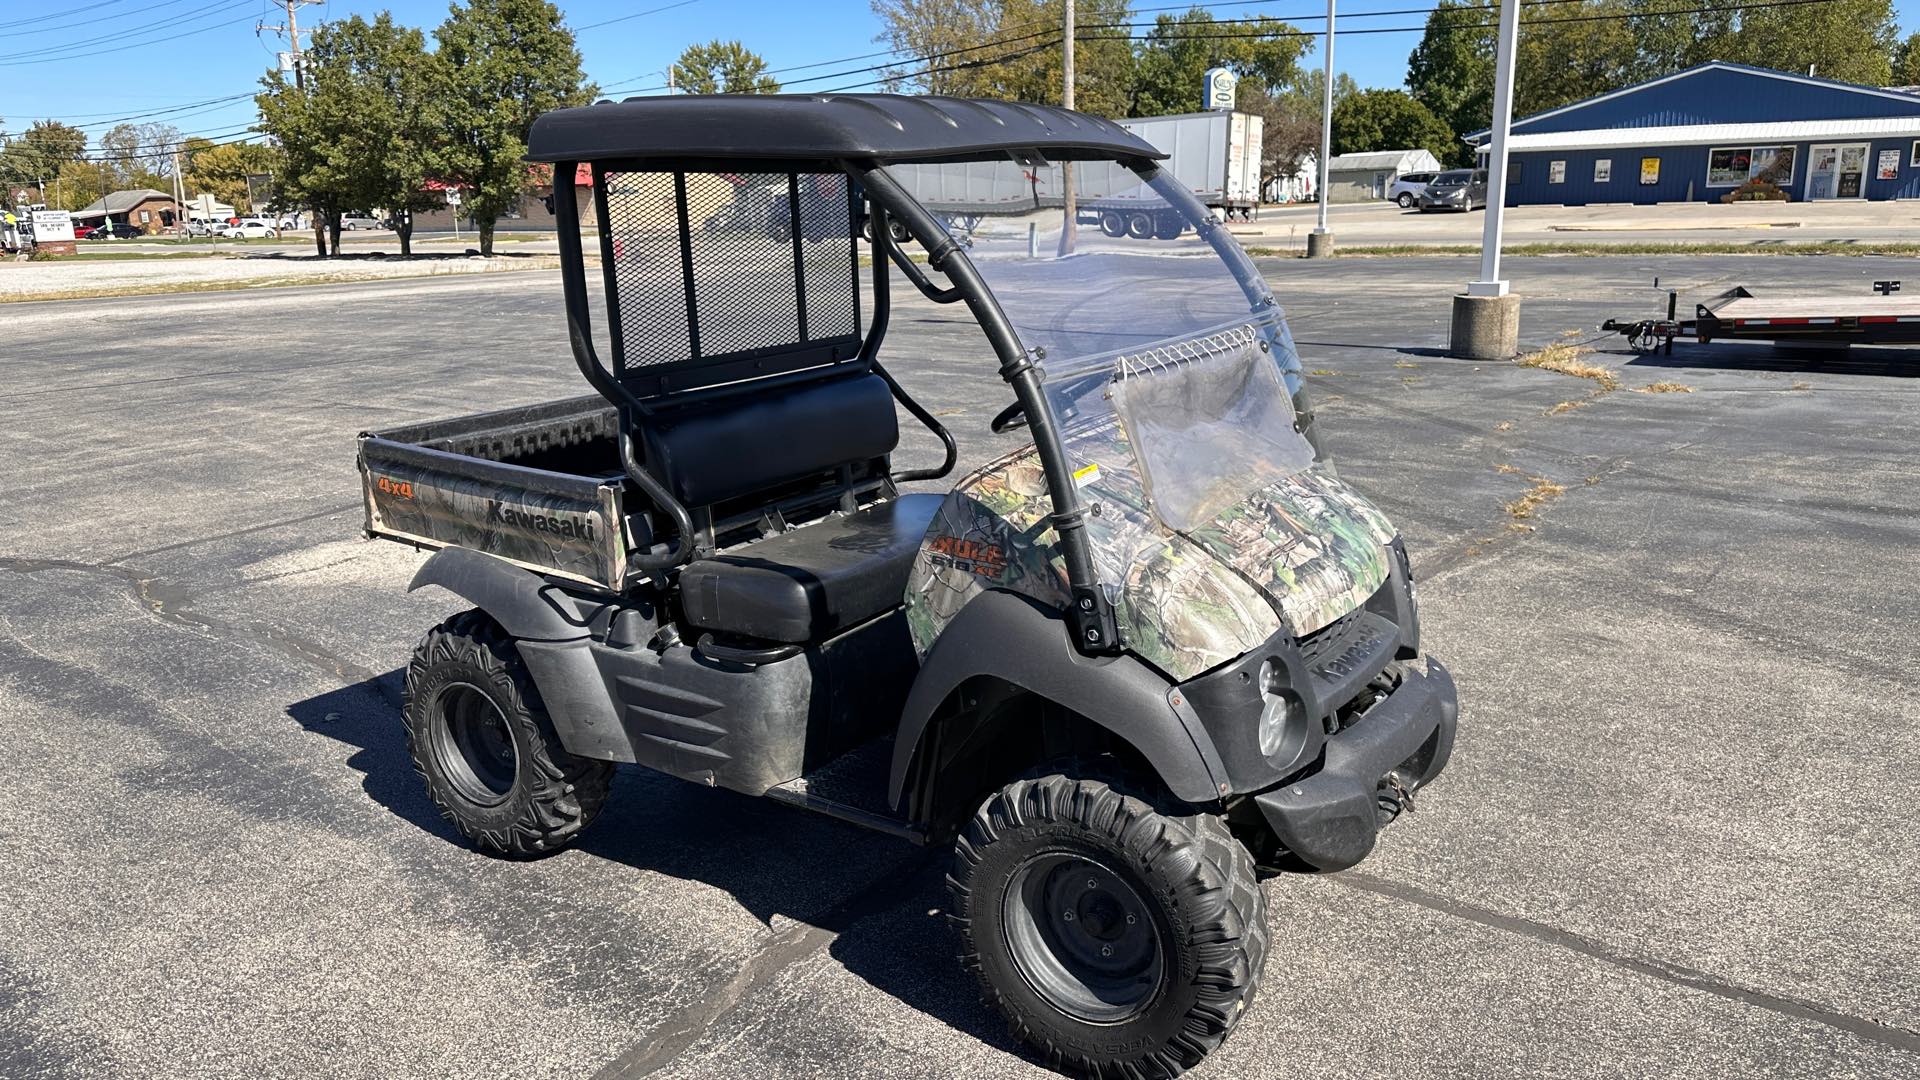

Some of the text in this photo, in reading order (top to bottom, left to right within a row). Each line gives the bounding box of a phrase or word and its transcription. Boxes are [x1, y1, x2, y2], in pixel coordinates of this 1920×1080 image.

[377, 475, 414, 499] 4x4
[488, 499, 594, 541] Kawasaki
[928, 536, 1007, 566] MULE
[1311, 624, 1382, 685] Kawasaki
